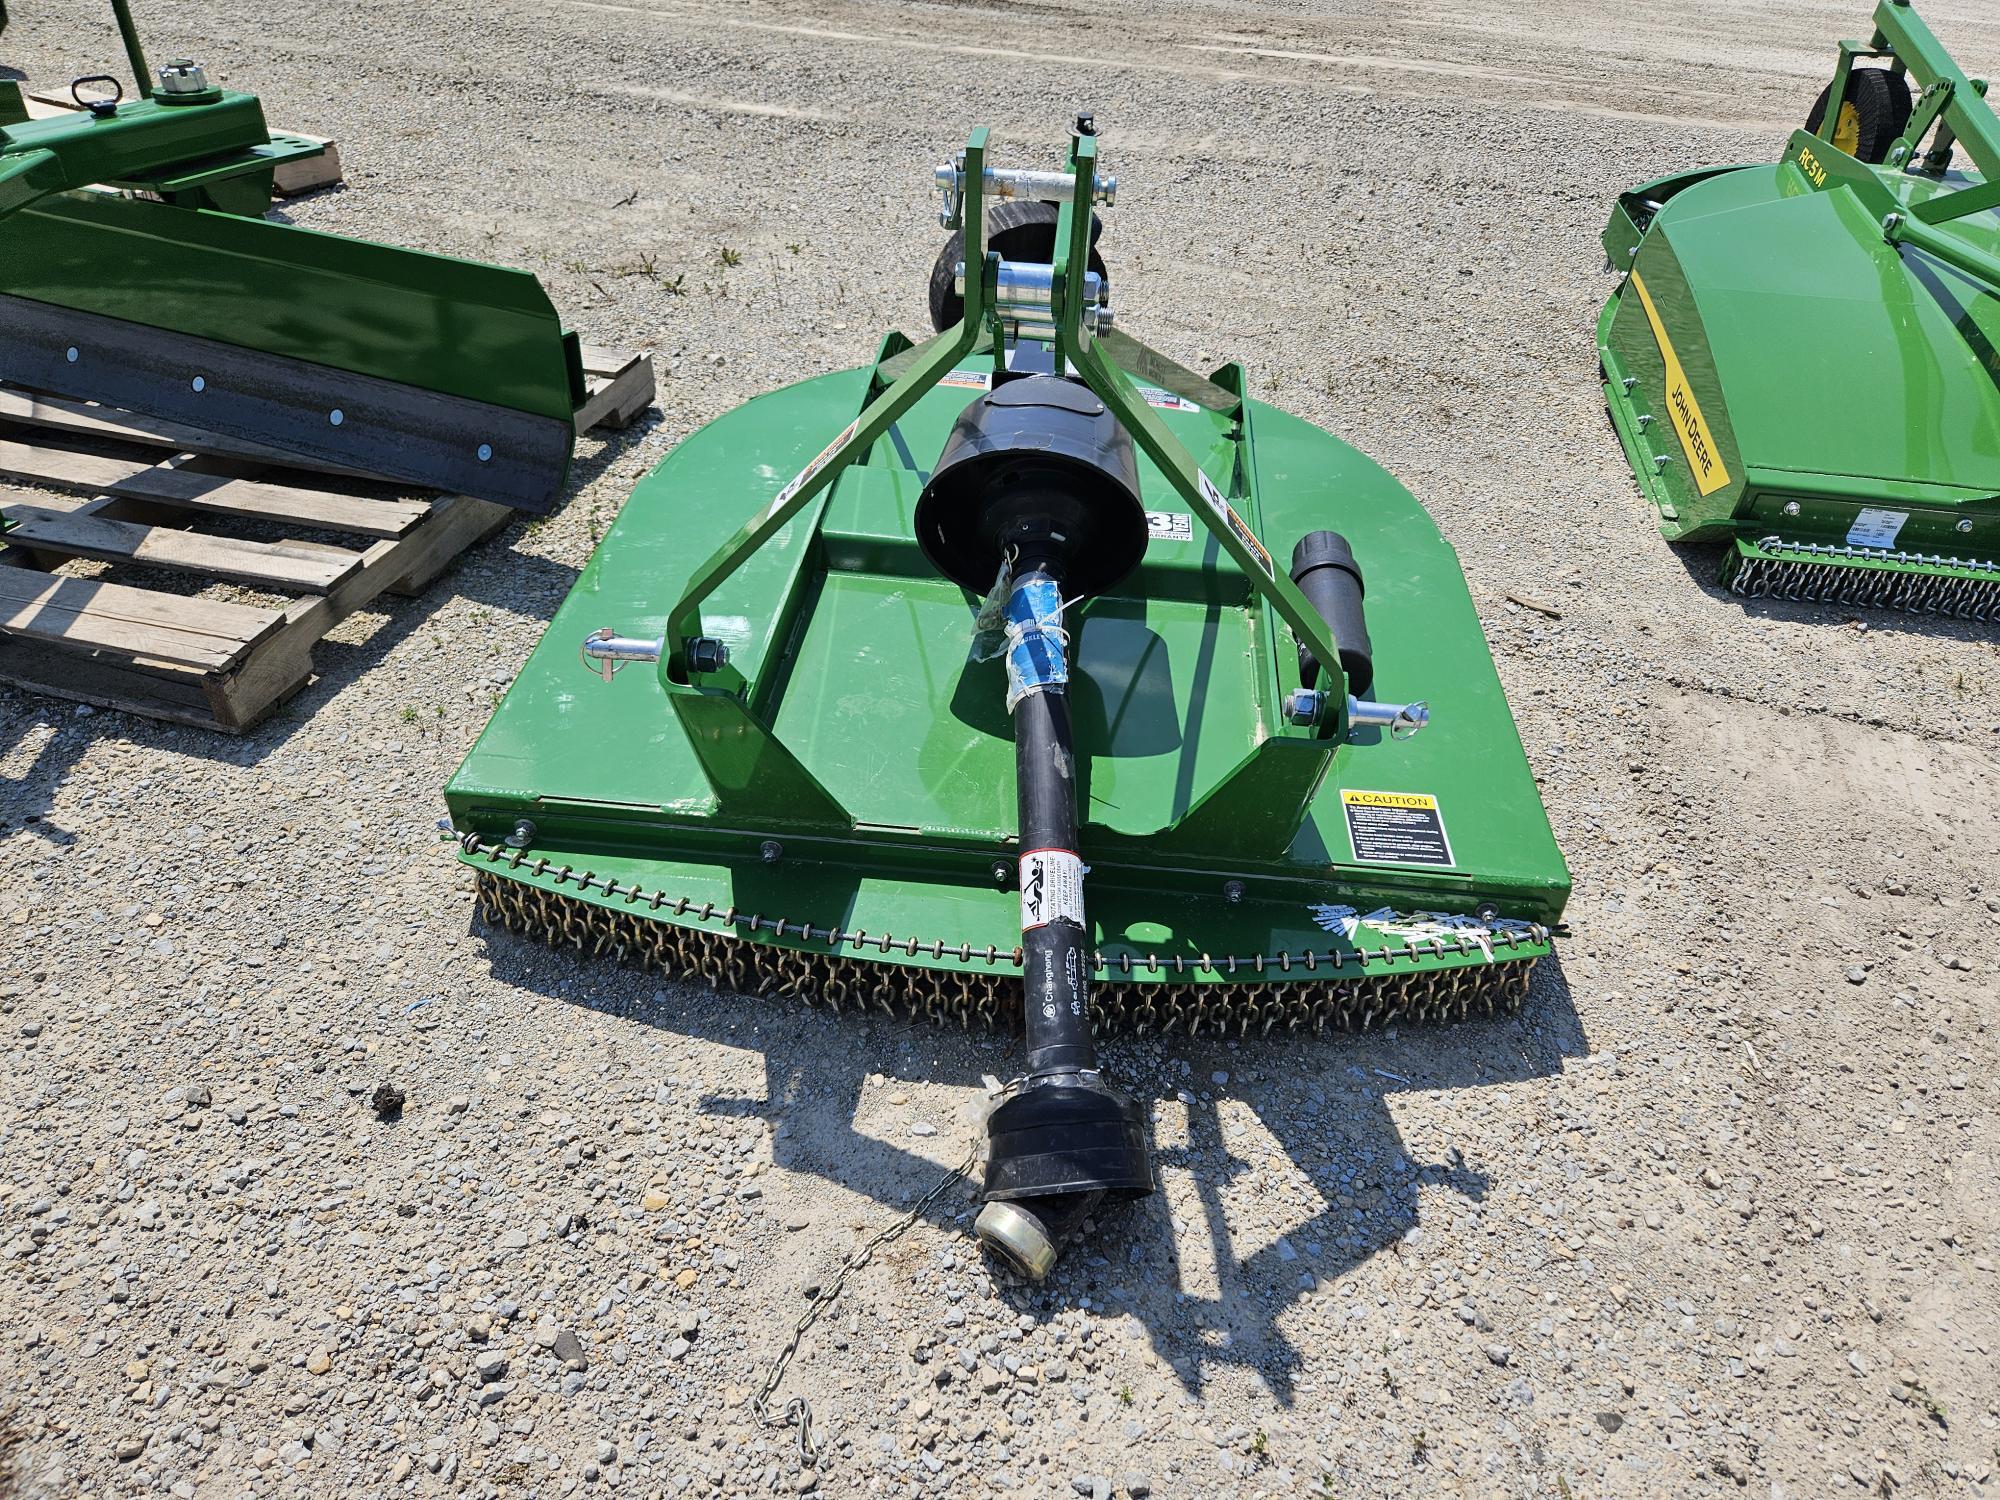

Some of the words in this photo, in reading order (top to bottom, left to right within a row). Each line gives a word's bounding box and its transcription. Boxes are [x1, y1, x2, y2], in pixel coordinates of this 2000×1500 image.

[1798, 146, 1827, 188] RC5M
[1672, 383, 1691, 428] JOHN
[1688, 417, 1712, 479] DEERE
[1145, 512, 1172, 531] 3
[1362, 794, 1428, 806] CAUTION
[1043, 949, 1054, 1002] Changhong
